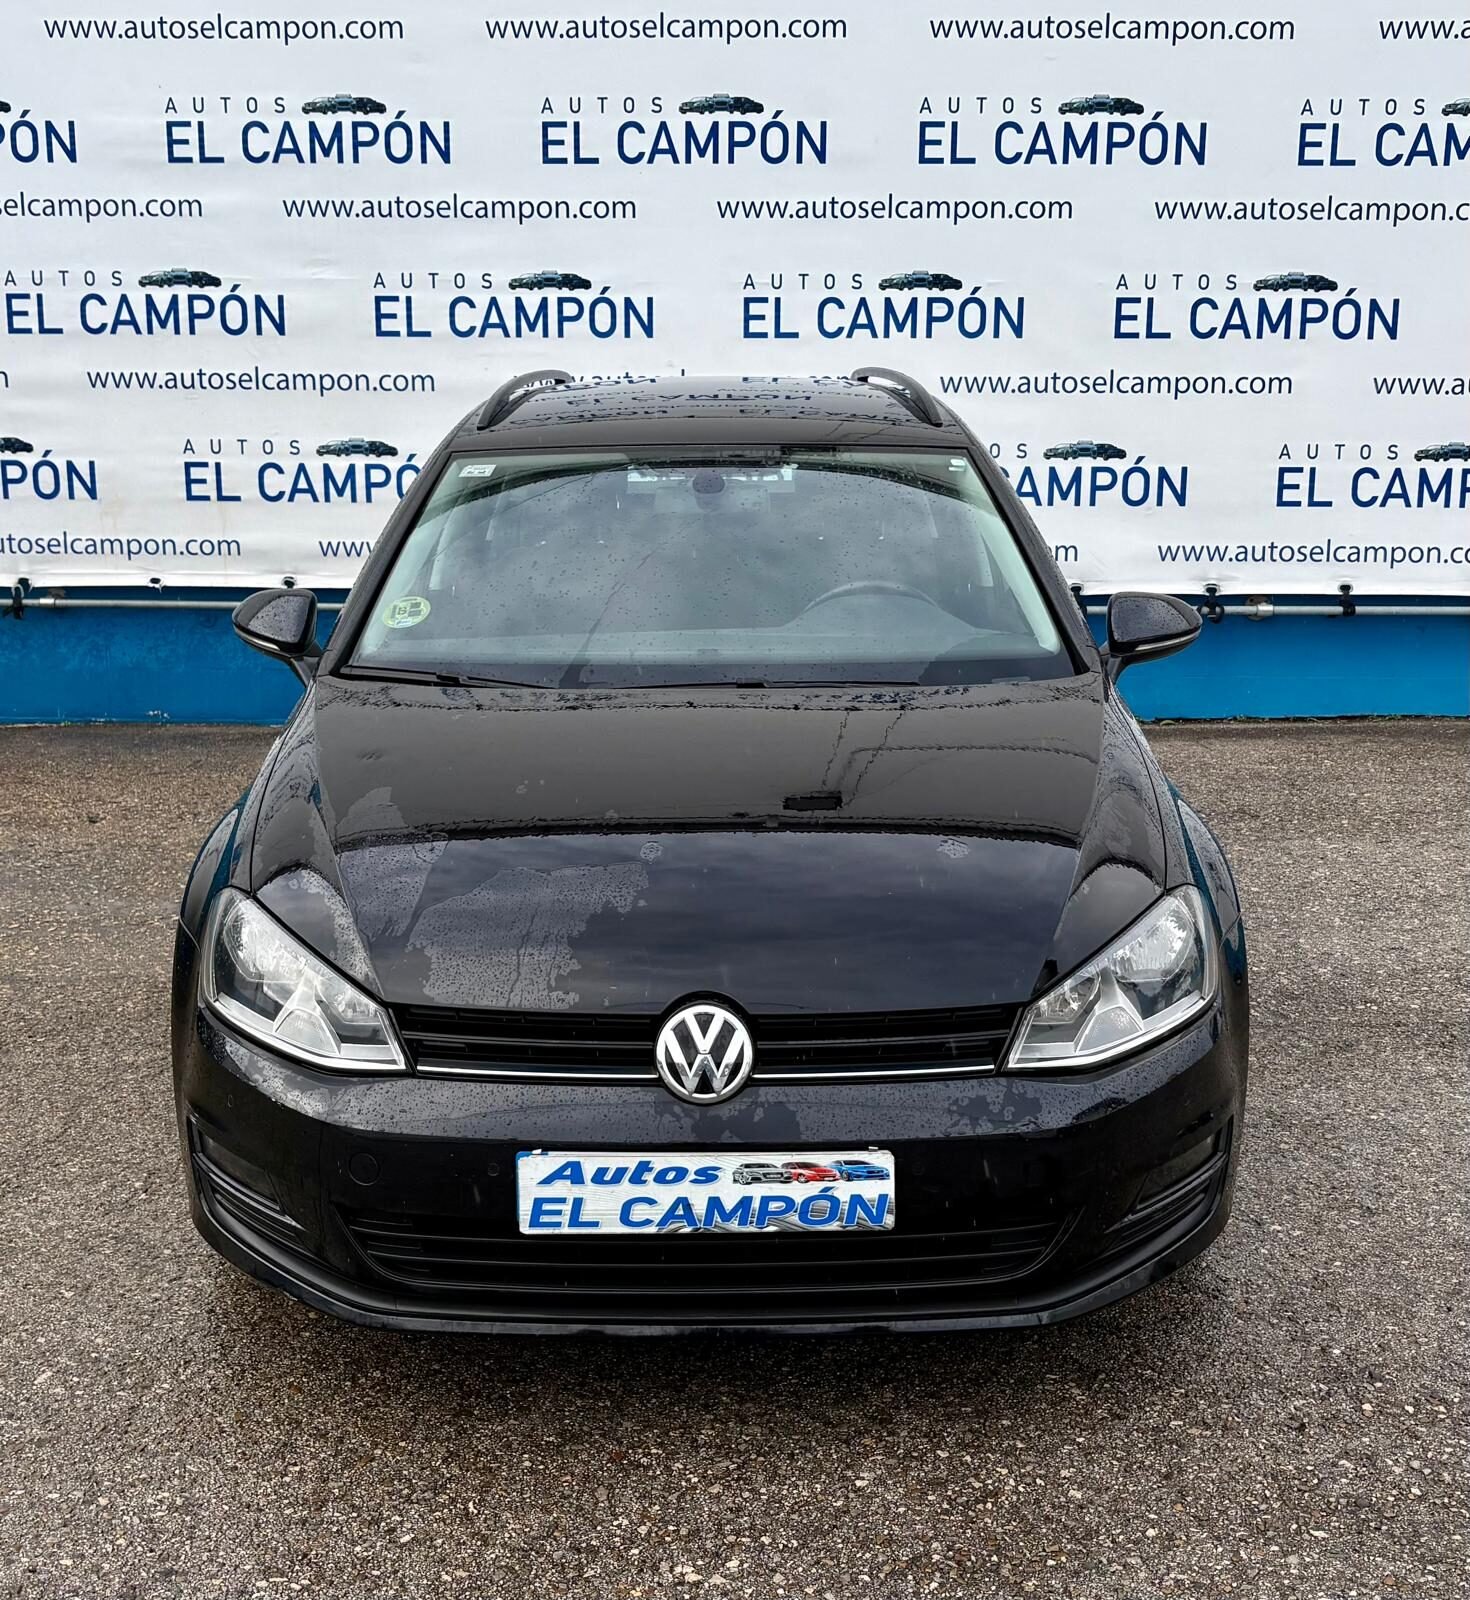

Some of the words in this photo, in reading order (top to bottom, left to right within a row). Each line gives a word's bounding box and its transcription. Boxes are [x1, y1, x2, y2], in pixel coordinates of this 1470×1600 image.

[43, 13, 404, 46] www.autoselcampon.com
[485, 11, 847, 45] www.autoselcampon.com
[929, 12, 1295, 47] www.autoselcampon.com
[164, 96, 286, 114] AUTOS
[540, 96, 663, 114] AUTOS
[919, 96, 1042, 114] AUTOS
[1300, 98, 1425, 116] AUTOS
[0, 109, 78, 164] ÓN
[165, 120, 225, 164] EL
[241, 110, 451, 165] CAMPÓN
[541, 120, 600, 165] EL
[617, 109, 827, 165] CAMPÓN
[918, 120, 977, 165] EL
[994, 111, 1208, 166] CAMPÓN
[1297, 122, 1356, 167] EL
[0, 191, 203, 224] elcampon.com
[282, 192, 636, 226] www.autoselcampon.com
[716, 193, 1073, 226] www.autoselcampon.com
[4, 270, 123, 287] AUTOS
[373, 272, 493, 290] AUTOS
[743, 273, 863, 290] AUTOS
[1115, 273, 1237, 291] AUTOS
[5, 292, 64, 335] EL
[79, 283, 286, 337] CAMPÓN
[374, 295, 432, 338] EL
[448, 286, 654, 339] CAMPÓN
[743, 296, 800, 339] EL
[817, 286, 1025, 339] CAMPÓN
[1113, 296, 1172, 339] EL
[1189, 287, 1400, 341] CAMPÓN
[86, 365, 435, 398] www.autoselcampon.com
[939, 369, 1293, 401] www.autoselcampon.com
[183, 438, 301, 456] AUTOS
[1278, 443, 1399, 461] AUTOS
[183, 461, 242, 502] EL
[1000, 456, 1189, 507] AMPÓN
[1276, 466, 1333, 508] EL
[537, 1160, 721, 1185] Autos
[528, 1196, 600, 1228] EL
[619, 1186, 890, 1228] CAMPÓN
